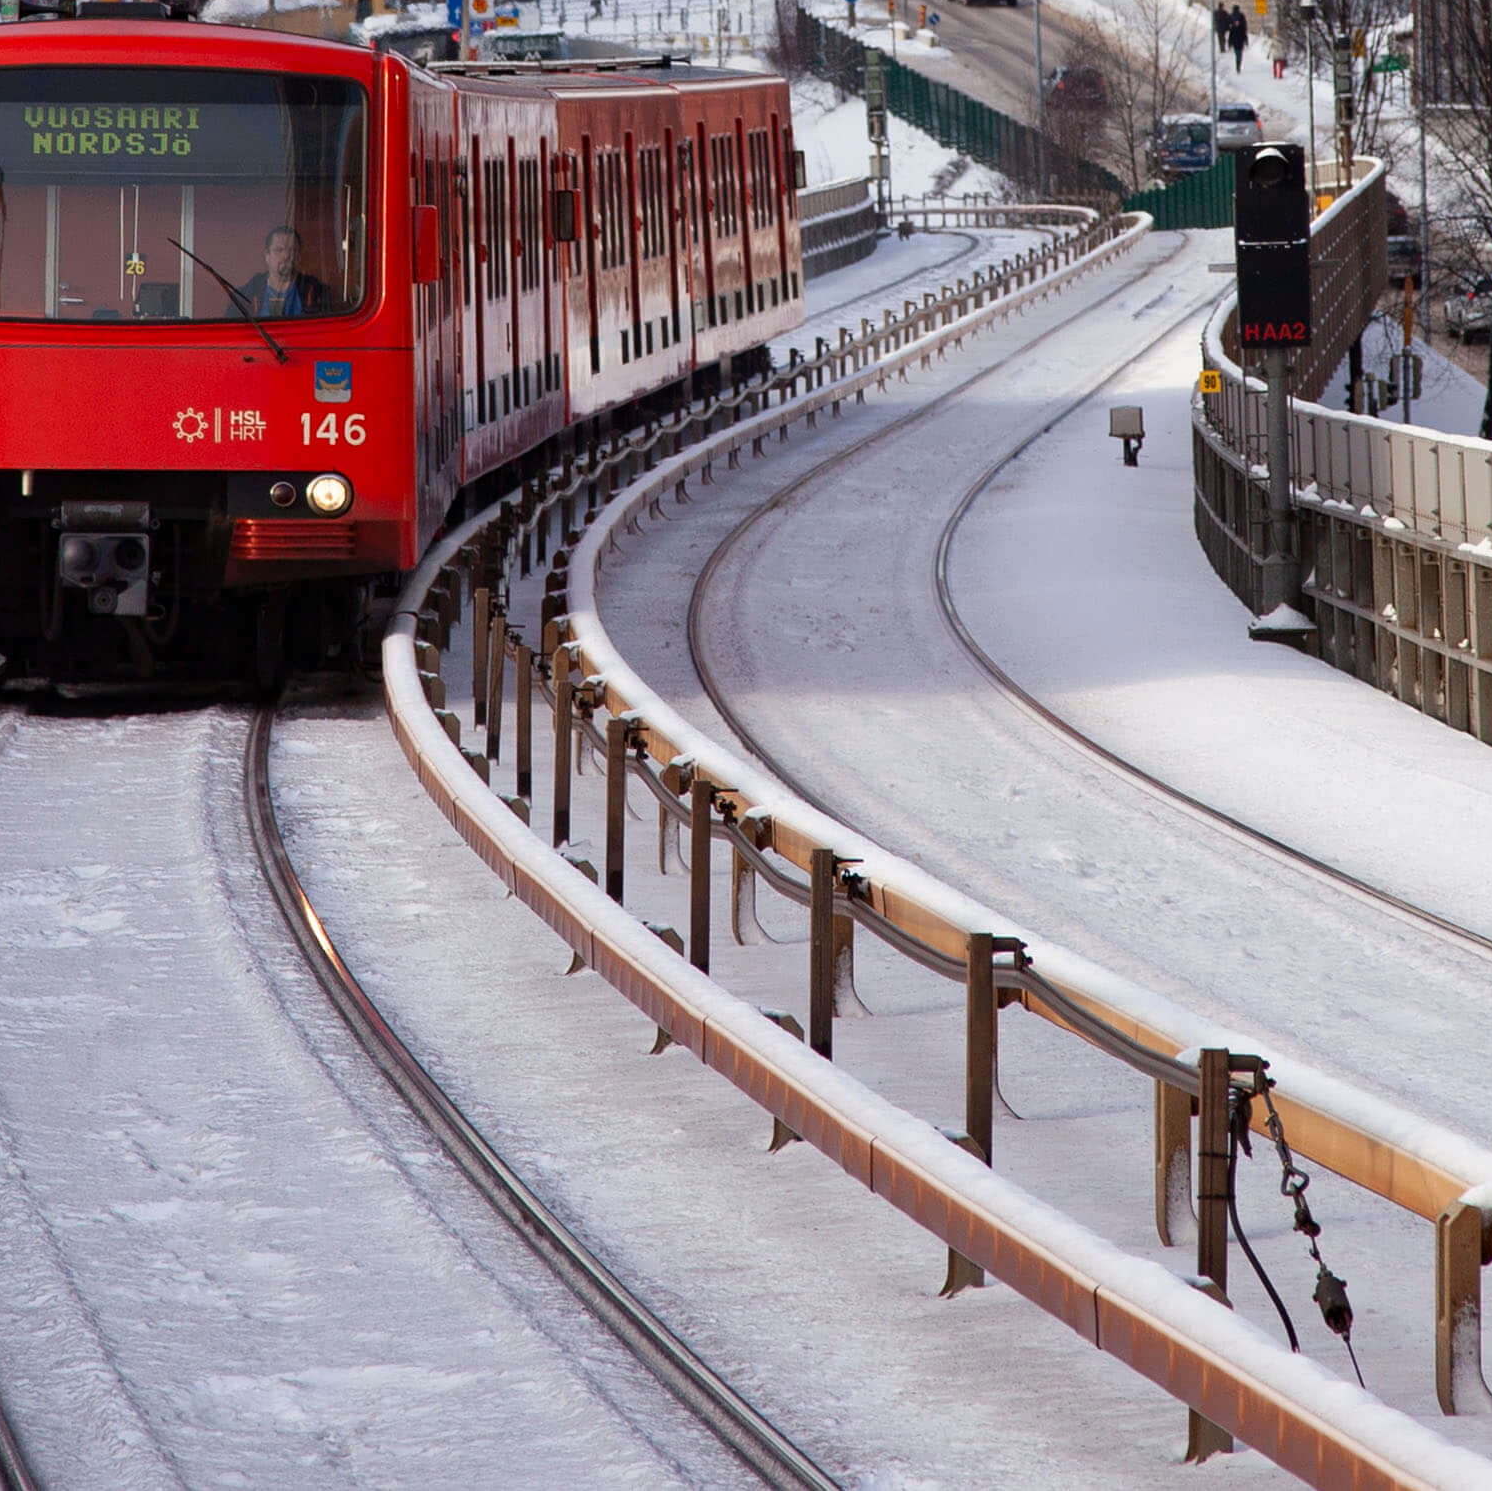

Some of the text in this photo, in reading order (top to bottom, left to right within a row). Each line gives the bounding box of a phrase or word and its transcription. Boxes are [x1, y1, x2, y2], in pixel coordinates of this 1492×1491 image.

[24, 106, 200, 129] VUOSAARI
[125, 260, 146, 275] 26
[1244, 322, 1306, 341] HAA2
[230, 410, 267, 425] HSL
[230, 426, 267, 441] HRT
[300, 412, 367, 446] 146
